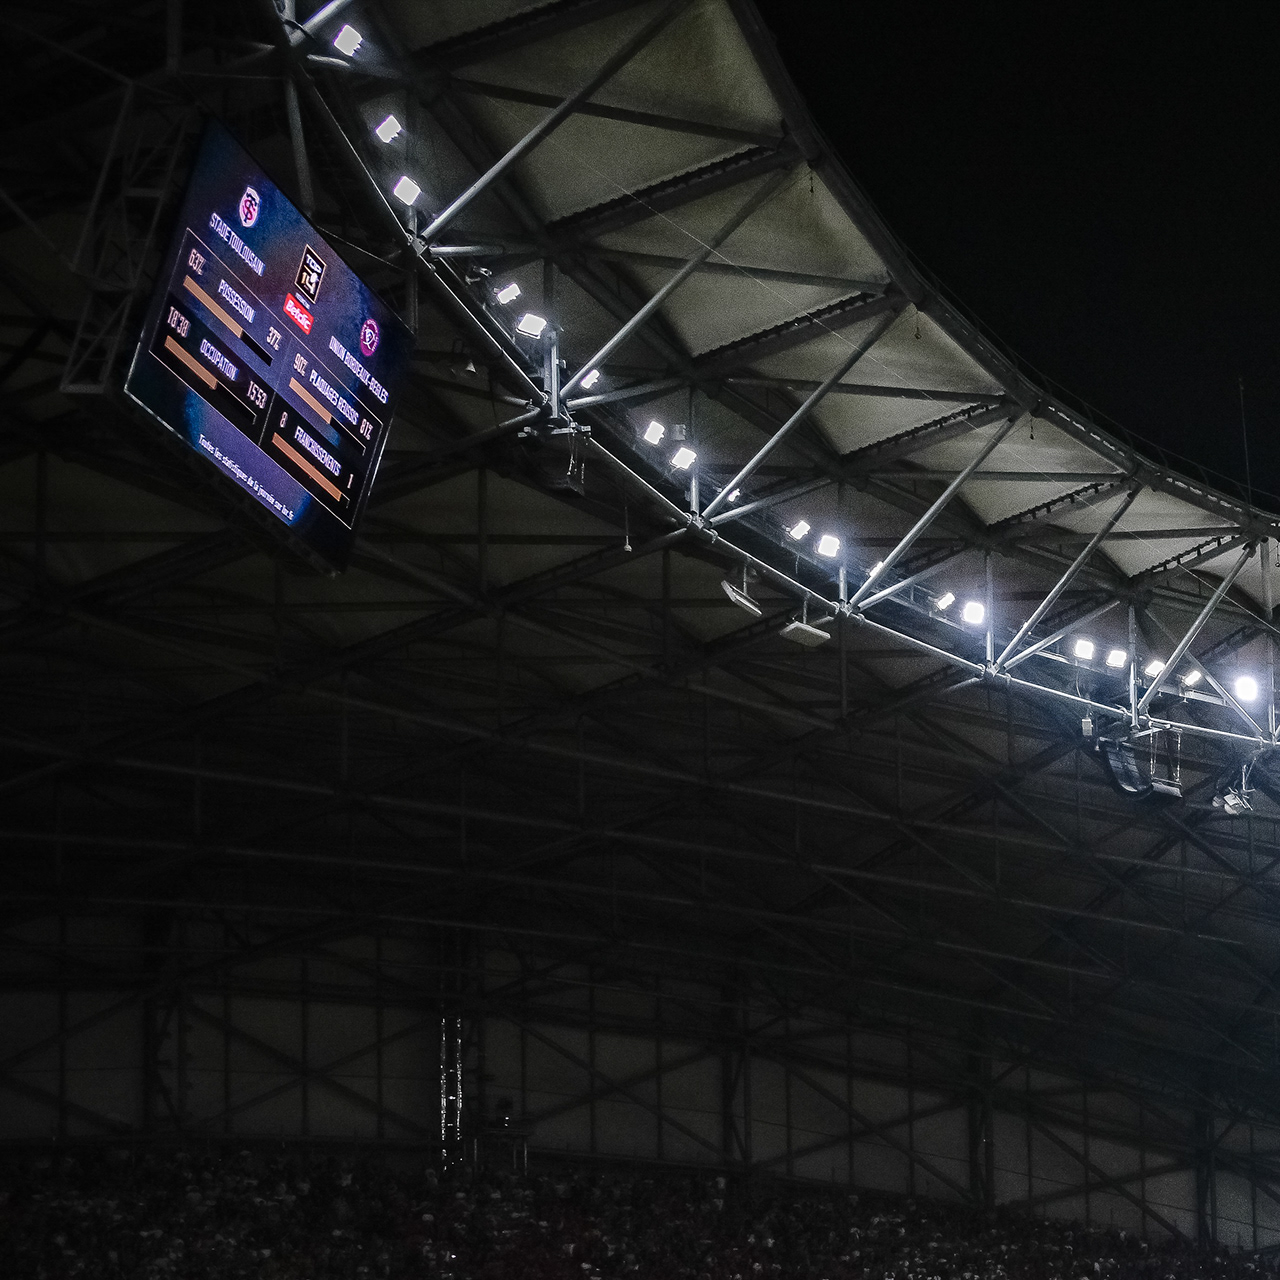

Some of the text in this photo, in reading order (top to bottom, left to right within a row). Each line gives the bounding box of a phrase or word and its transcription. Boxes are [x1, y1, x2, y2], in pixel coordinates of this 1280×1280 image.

[209, 212, 265, 277] STADE TOULOUSAIN
[188, 248, 206, 275] 63%
[305, 253, 322, 273] TOP
[218, 279, 256, 323] POSSESSION
[285, 299, 311, 330] Betclic
[267, 326, 282, 351] 37%
[329, 335, 346, 361] UNION
[200, 338, 239, 381] OCCUPATION
[293, 353, 309, 376] 90%
[279, 411, 288, 428] 8
[294, 425, 342, 476] FRANCHISSEMENTS
